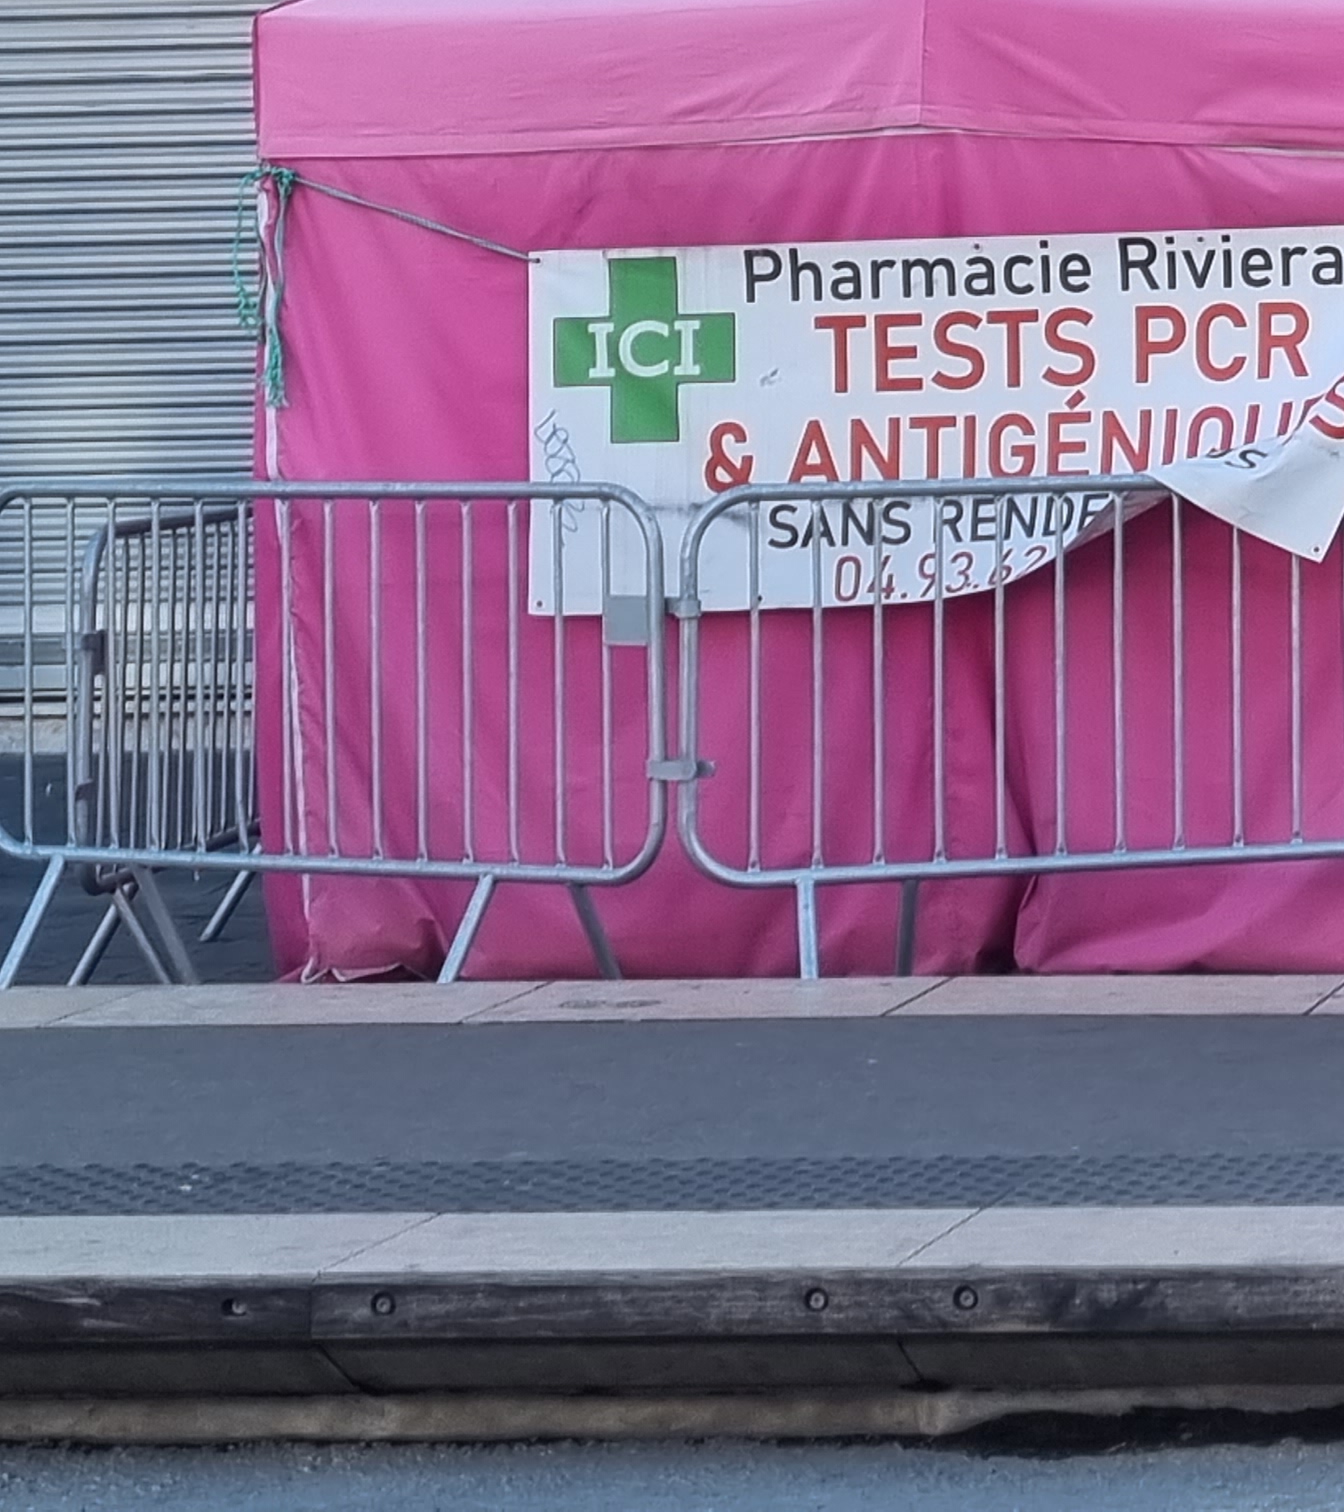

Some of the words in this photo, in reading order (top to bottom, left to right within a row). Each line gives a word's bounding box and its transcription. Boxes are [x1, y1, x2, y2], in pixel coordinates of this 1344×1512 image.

[744, 239, 1092, 303] Pharmacie
[1118, 235, 1344, 291] Riviera
[589, 319, 700, 379] ICI
[815, 307, 1096, 393] TESTS
[1135, 302, 1309, 383] PCR
[705, 422, 754, 492] &
[768, 496, 912, 549] SANS
